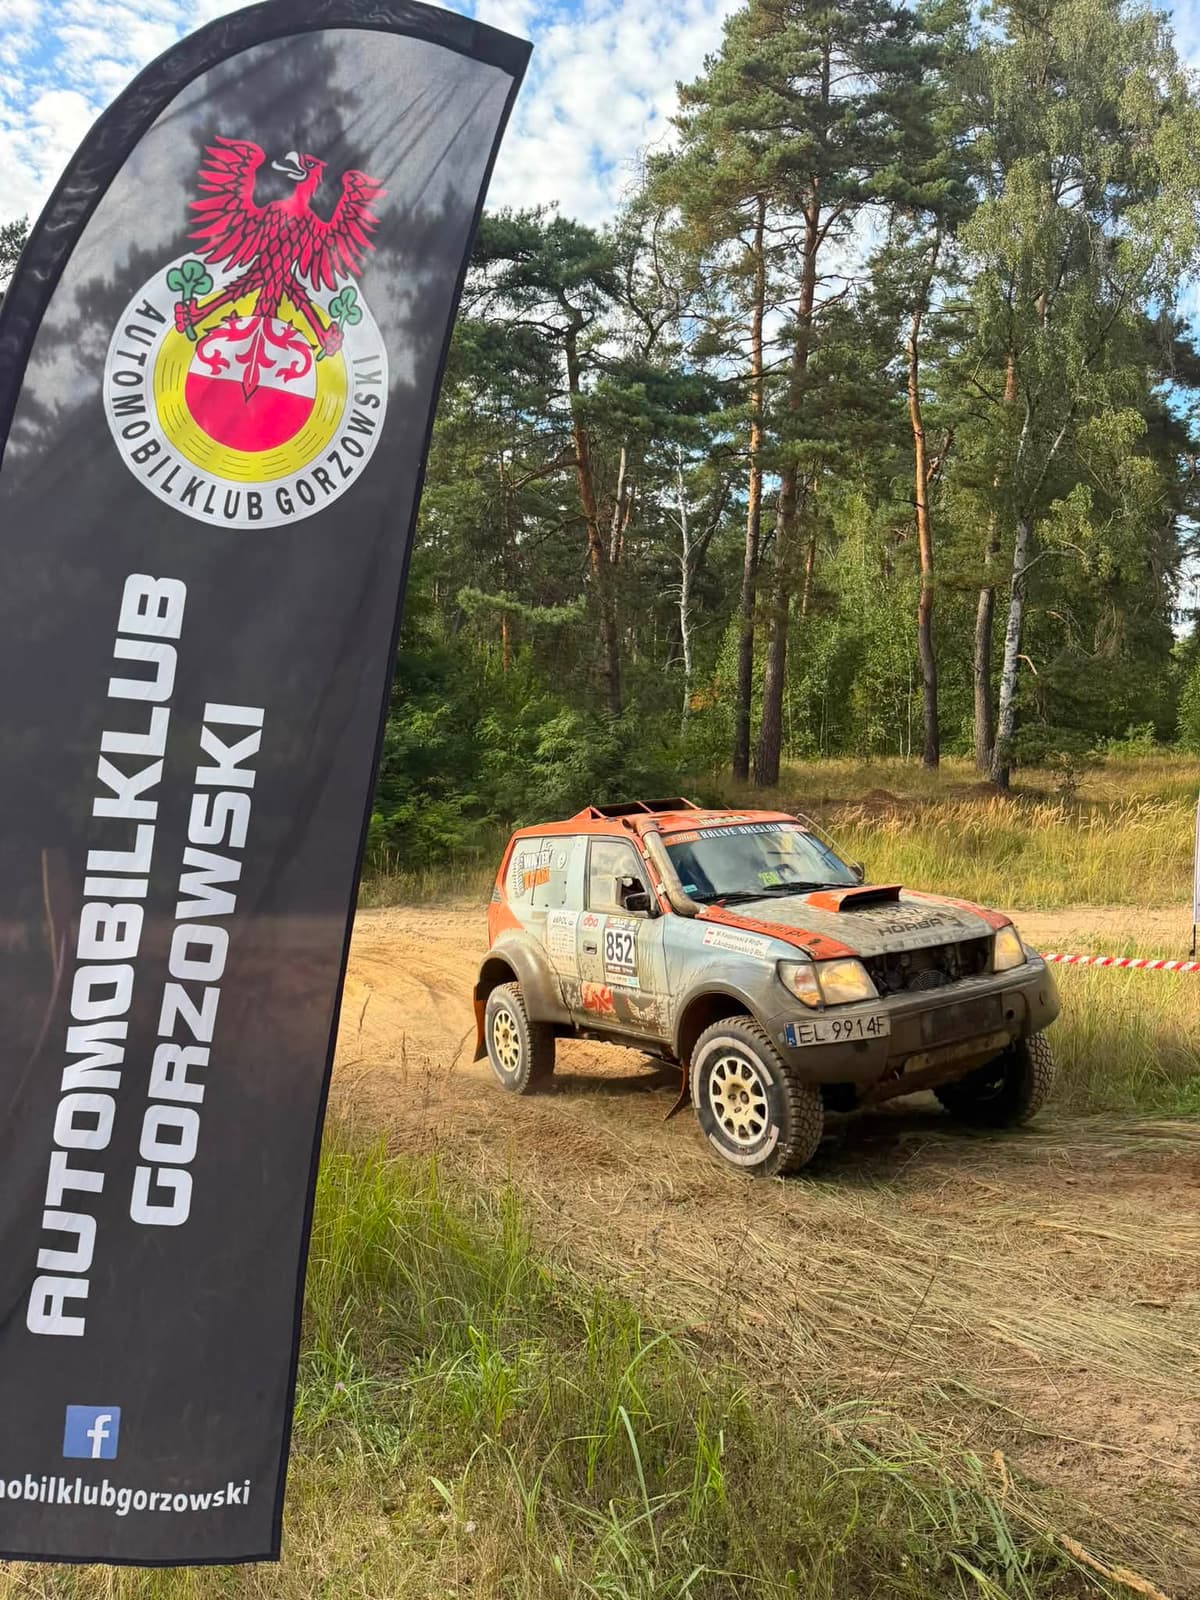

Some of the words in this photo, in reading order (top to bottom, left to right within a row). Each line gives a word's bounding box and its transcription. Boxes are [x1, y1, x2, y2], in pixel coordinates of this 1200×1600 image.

[111, 298, 263, 521] AUTOMOBILKLUB
[275, 354, 383, 516] GORZOWSKI
[700, 827, 737, 839] RALLYE
[738, 823, 781, 834] BRESLAU
[26, 573, 188, 1337] AUTOMOBILKLUB
[130, 702, 265, 1226] GORZOWSKI
[606, 931, 633, 964] 852
[797, 1023, 825, 1044] EL
[831, 1016, 885, 1040] 9914F
[0, 1473, 251, 1516] obilklubgorzowski
